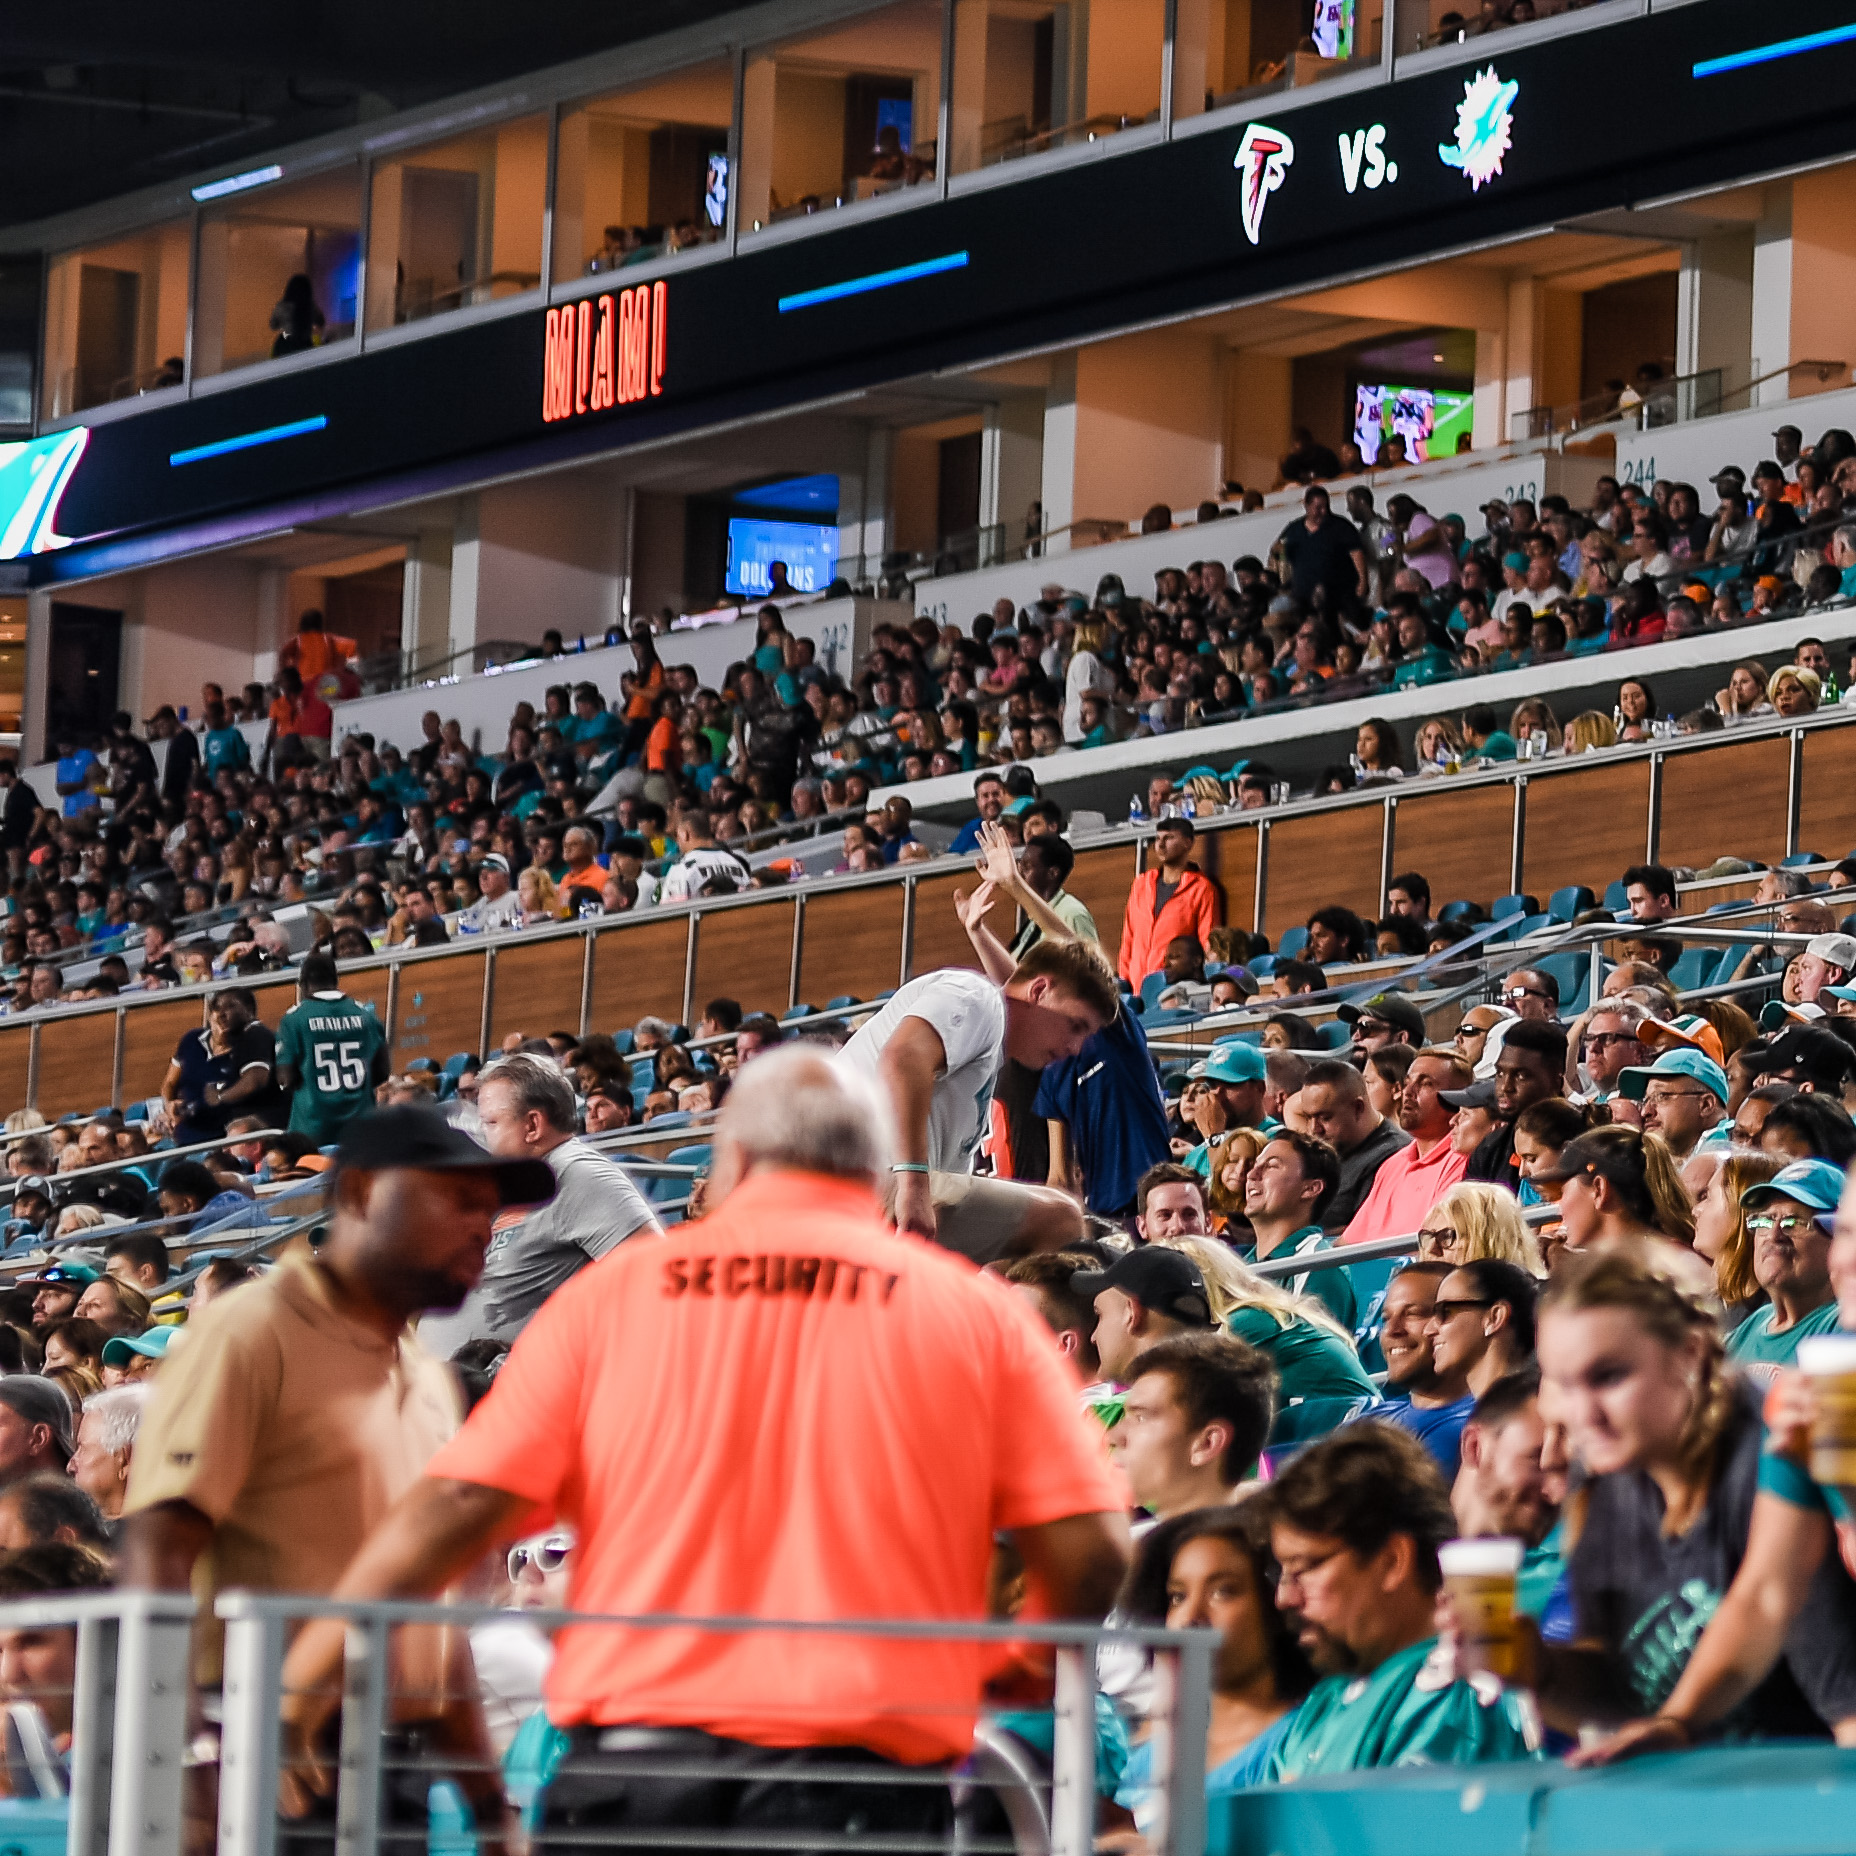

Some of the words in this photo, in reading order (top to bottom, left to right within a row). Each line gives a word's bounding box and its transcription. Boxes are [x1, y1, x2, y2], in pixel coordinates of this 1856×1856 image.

[542, 280, 668, 423] MIAMI
[1623, 455, 1656, 487] 244
[308, 1015, 363, 1032] GRAHAM
[314, 1041, 366, 1092] 55
[662, 1254, 900, 1306] SECURITY
